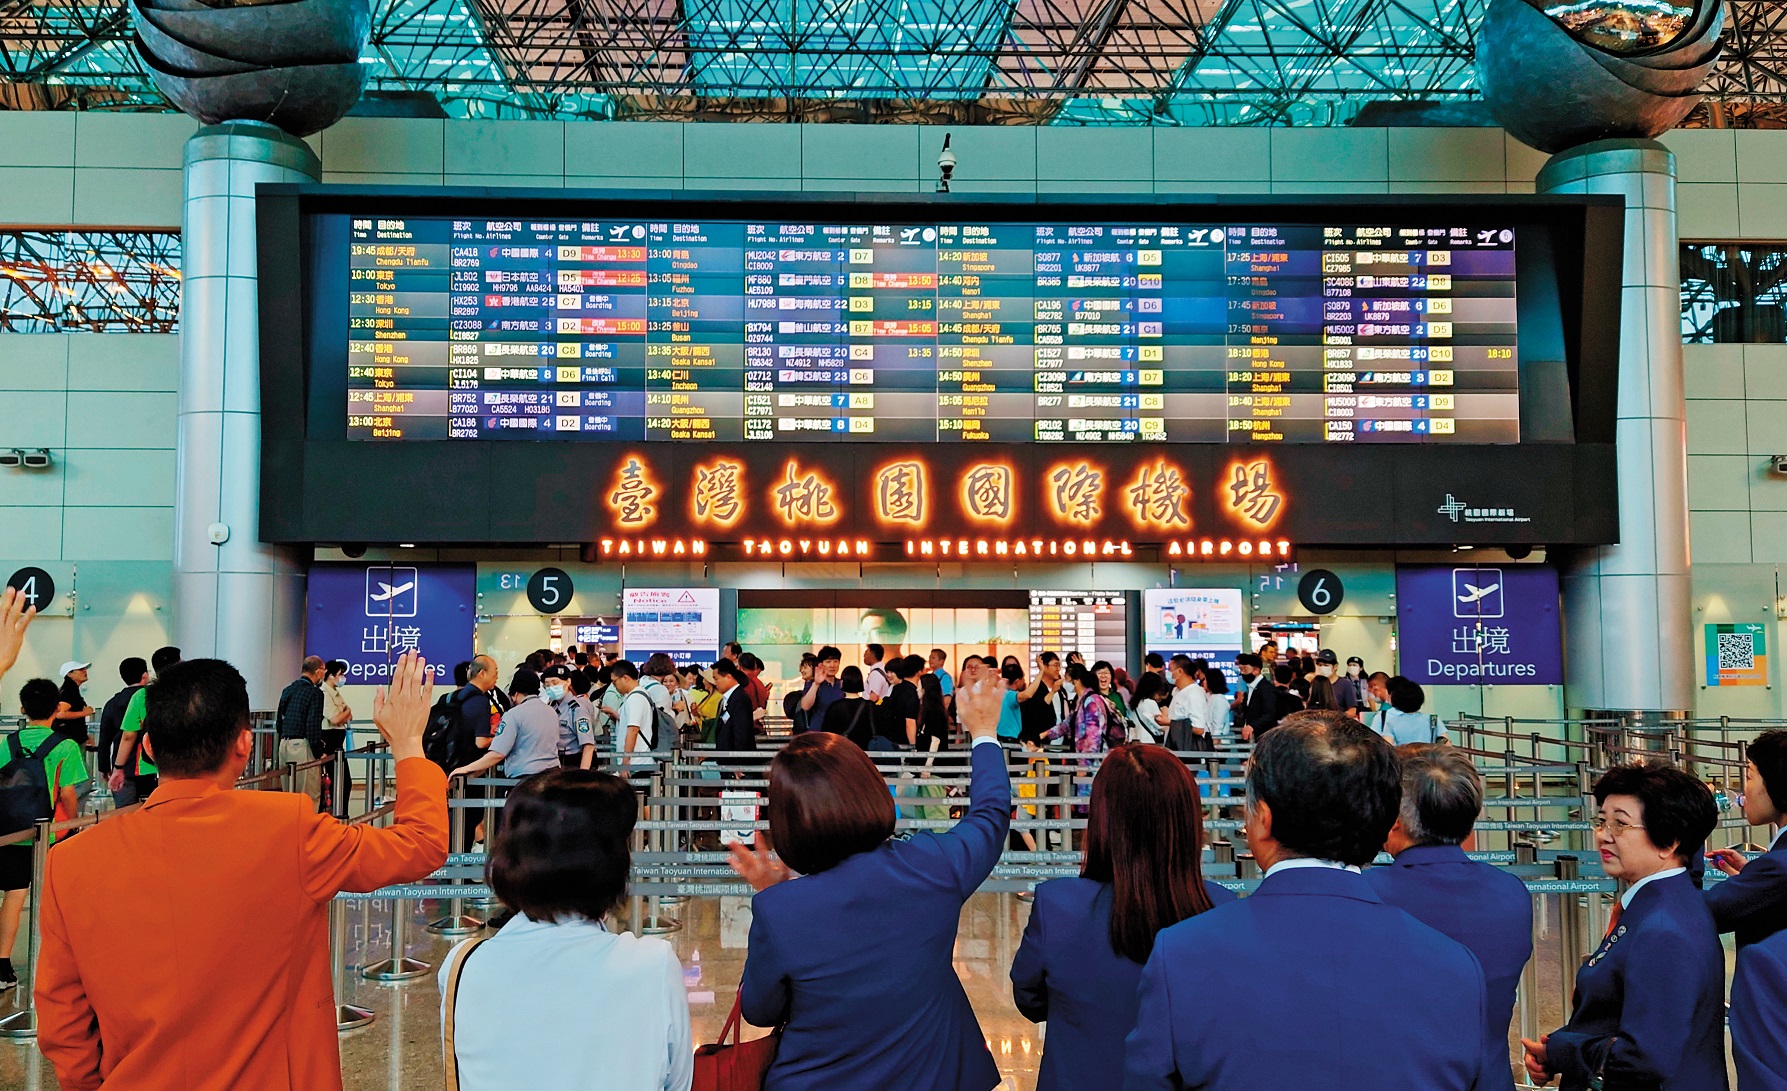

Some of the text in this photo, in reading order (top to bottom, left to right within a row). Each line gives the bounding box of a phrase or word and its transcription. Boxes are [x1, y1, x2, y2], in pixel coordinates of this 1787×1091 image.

[378, 220, 404, 230] 目的地
[453, 221, 471, 231] 班次
[486, 222, 522, 231] 航空公司
[351, 246, 376, 256] 19:45
[376, 246, 416, 256] 成都/天府
[454, 247, 478, 257] CA418
[562, 249, 577, 258] D9
[617, 250, 641, 259] 13:30
[648, 249, 671, 259] 13:00
[748, 251, 776, 260] MU2042
[939, 252, 962, 261] 14:20
[1083, 252, 1120, 262] 新加坡航
[1228, 253, 1250, 262] 17:25
[1432, 254, 1446, 262] D3
[376, 258, 429, 266] Chengdu Tianfu
[962, 264, 995, 272] Singapore
[351, 270, 376, 280] 10:00
[376, 270, 394, 280] 東京
[454, 272, 478, 281] JL802
[502, 272, 539, 282] 日本航空
[908, 275, 932, 285] 13:50
[939, 276, 962, 285] 14:40
[376, 282, 396, 290] Tokyo
[454, 283, 479, 292] CI9902
[351, 295, 375, 304] 12:30
[454, 296, 478, 305] HX253
[502, 296, 539, 306] 香港航空
[542, 297, 555, 306] 25
[562, 297, 576, 306] C7
[854, 299, 868, 309] D3
[908, 300, 932, 309] 13:15
[376, 307, 409, 315] Hong Kong
[672, 310, 699, 318] Beijing
[351, 319, 375, 329] 12:30
[501, 320, 538, 330] 南方航空
[648, 322, 671, 331] 13:25
[908, 324, 932, 333] 15:05
[1038, 324, 1061, 333] BR765
[939, 324, 962, 334] 14:45
[1327, 325, 1355, 334] MU5002
[375, 331, 406, 339] Shenzhen
[671, 334, 691, 342] Busan
[962, 335, 1014, 343] Chengdu Tianfu
[1251, 336, 1278, 344] Nanjing
[350, 343, 374, 353] 12:40
[672, 346, 710, 356] 大阪/關西
[908, 347, 932, 358] 13:35
[1228, 348, 1252, 358] 18:10
[1487, 348, 1512, 359] 18:10
[671, 358, 716, 366] Osaka Kansai
[962, 359, 993, 367] Shenzhen
[350, 368, 374, 377] 12:40
[453, 369, 478, 378] CI104
[648, 370, 671, 380] 13:40
[672, 370, 689, 380] 仁川
[1228, 372, 1252, 382] 18:20
[374, 380, 394, 388] Tokyo
[671, 382, 698, 390] Incheon
[962, 384, 996, 392] Guangzhou
[374, 404, 404, 413] Shanghai
[671, 406, 704, 415] Guangzhou
[349, 417, 374, 426] 13:00
[374, 417, 392, 427] 北京
[452, 418, 476, 427] CA186
[562, 419, 575, 428] D2
[647, 419, 671, 428] 14:20
[1328, 421, 1352, 430] CA150
[373, 429, 401, 437] Beijing
[692, 431, 716, 439] Kansai
[962, 432, 989, 440] Fukuoka
[1252, 432, 1283, 440] Hangzhou
[611, 460, 1281, 524] 臺灣桃園國際機場
[601, 540, 1291, 556] TAIWAN TAOYUAN INTERNATIONAL AIRPORT
[22, 576, 39, 605] 4
[541, 576, 560, 605] 5
[1312, 577, 1331, 606] 6
[361, 625, 421, 655] 出境
[1452, 626, 1511, 655] 出境
[1428, 659, 1536, 681] Departures
[1532, 799, 1551, 807] Airport
[689, 822, 713, 830] Taoyuan
[1048, 820, 1070, 829] Airport
[1526, 823, 1550, 831] Taoyuan
[1551, 822, 1589, 830] International
[461, 855, 487, 864] Taoyua
[1052, 853, 1077, 861] Taiwan
[1490, 852, 1516, 862] Airport
[634, 867, 659, 875] Taiwan
[660, 867, 692, 876] Taoyuan
[994, 867, 1081, 876] Taiwan Taoyuan Interna
[677, 883, 748, 895] 臺灣桃園國際機場
[1570, 882, 1600, 892] Airport
[402, 888, 438, 898] Taoyuan
